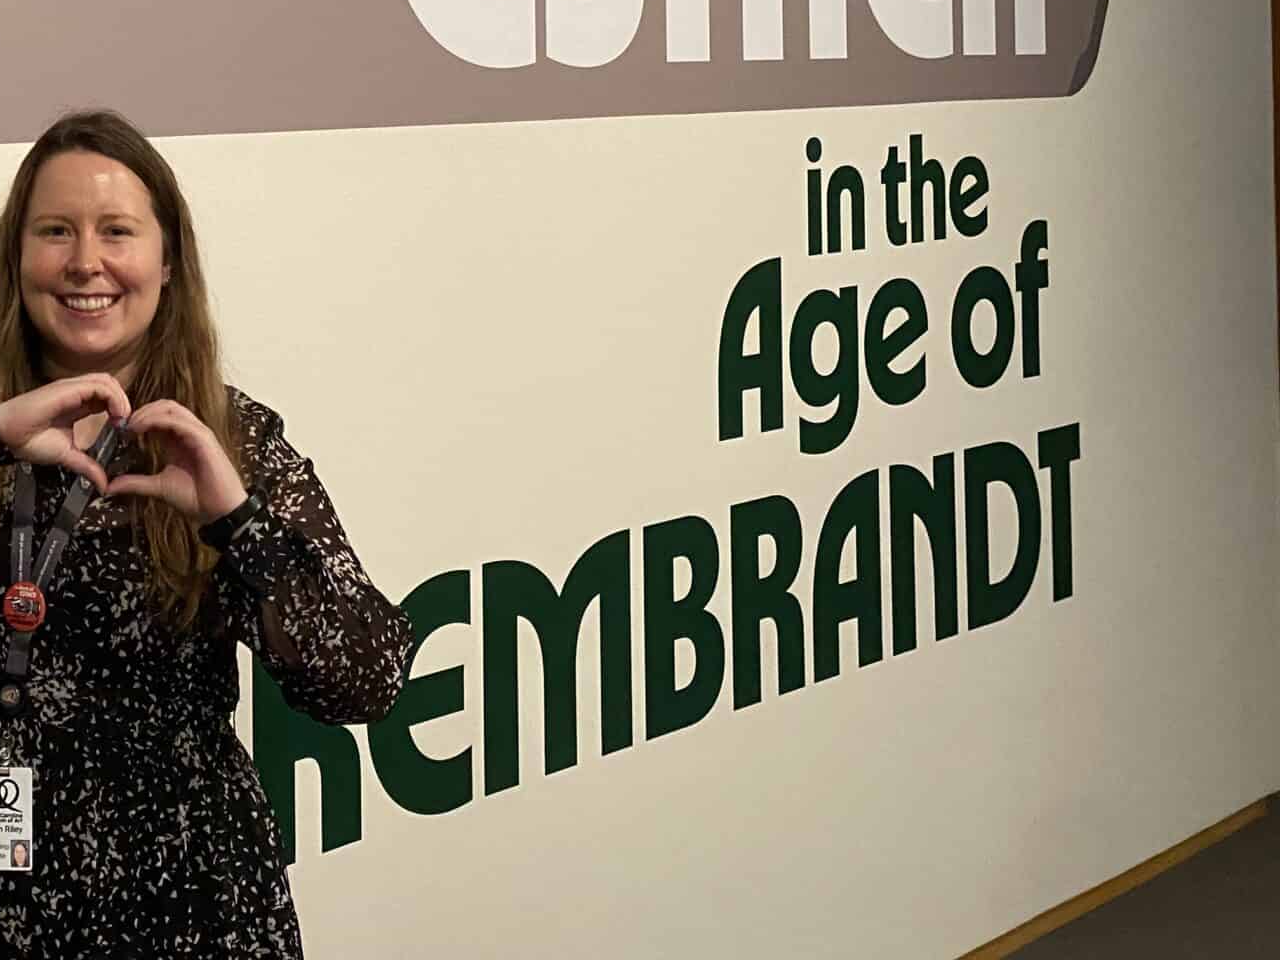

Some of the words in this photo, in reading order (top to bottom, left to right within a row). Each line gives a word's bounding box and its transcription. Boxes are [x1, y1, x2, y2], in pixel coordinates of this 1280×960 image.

[806, 137, 866, 257] in
[881, 133, 990, 246] the
[718, 257, 929, 454] Age
[951, 219, 1049, 389] of
